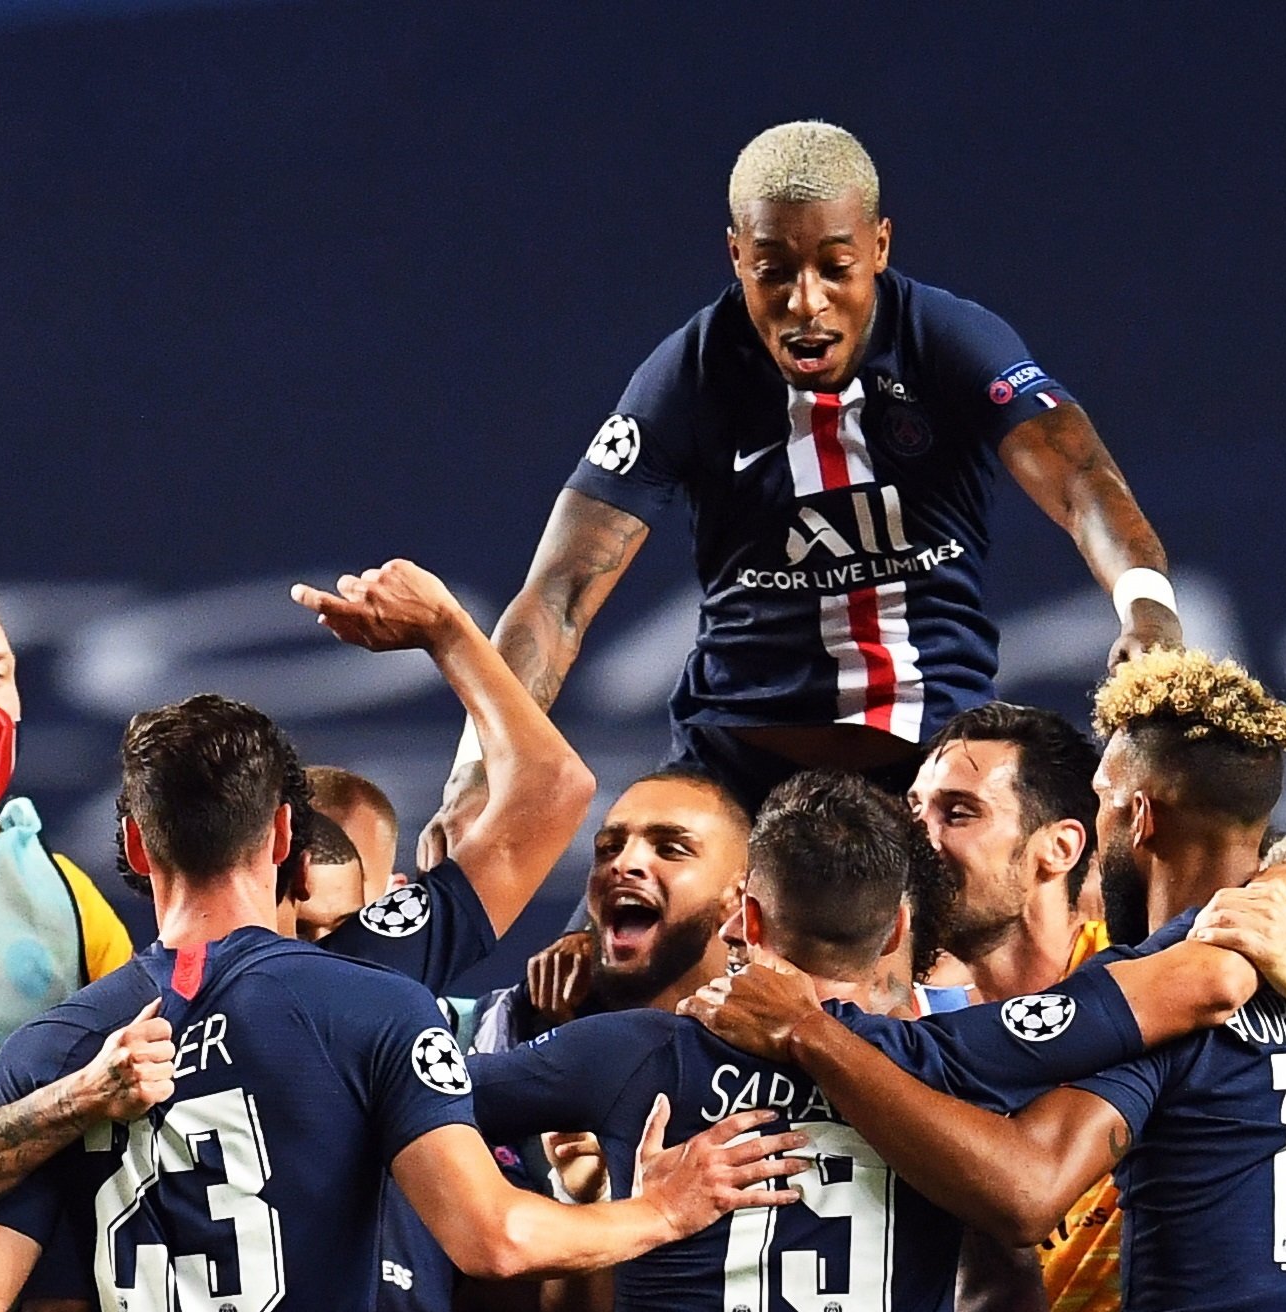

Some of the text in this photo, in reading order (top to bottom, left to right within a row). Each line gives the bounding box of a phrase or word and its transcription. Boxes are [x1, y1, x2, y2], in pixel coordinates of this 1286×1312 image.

[1007, 365, 1047, 388] RESP
[814, 563, 865, 589] LIVE
[172, 1013, 233, 1080] ER
[700, 1062, 832, 1123] SARA
